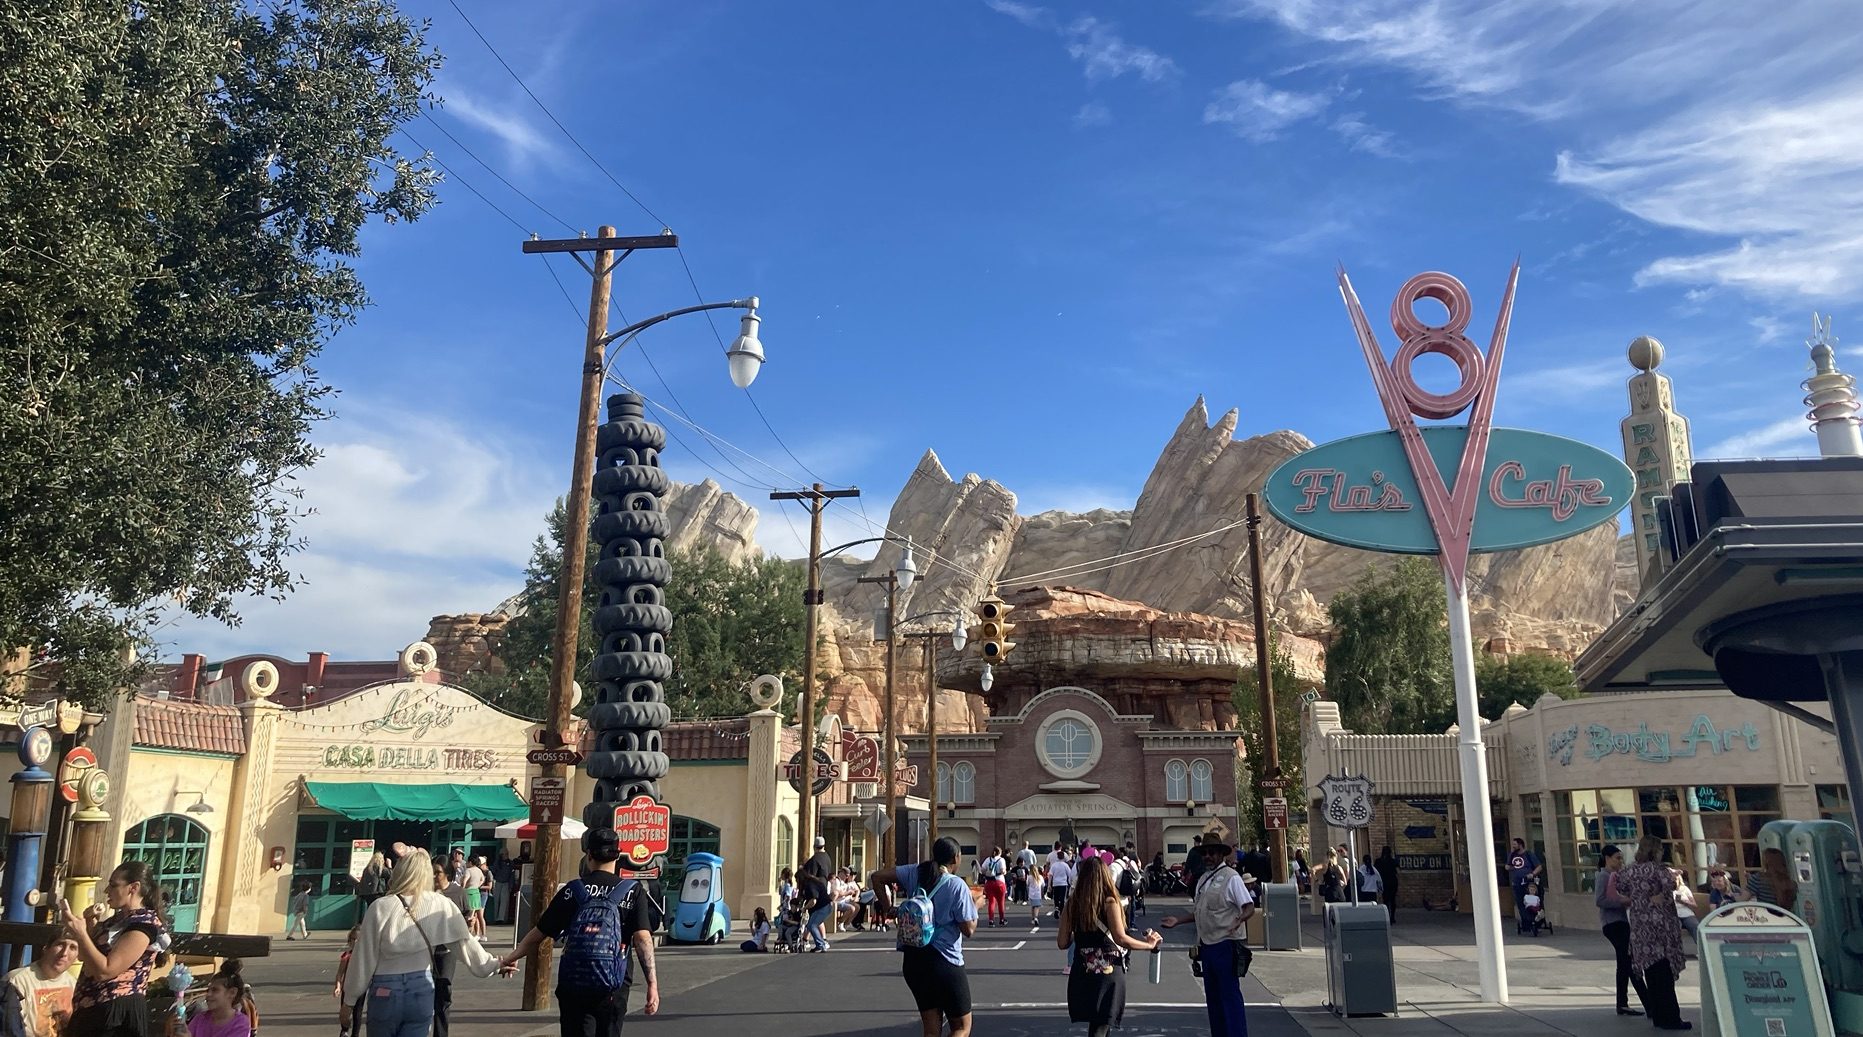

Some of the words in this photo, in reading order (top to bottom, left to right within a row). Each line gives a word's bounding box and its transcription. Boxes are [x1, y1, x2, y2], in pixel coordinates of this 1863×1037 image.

[1292, 469, 1413, 513] Flo's
[1489, 461, 1612, 522] Cafe
[23, 714, 38, 726] ONE
[38, 708, 53, 721] WAY
[1584, 720, 1671, 763] Body
[1682, 713, 1760, 755] Art
[323, 745, 375, 768] CASA
[378, 747, 439, 770] DELLA
[443, 748, 497, 772] TIRES
[532, 752, 558, 761] CROSS
[846, 744, 871, 762] Curb
[784, 764, 840, 778] TIES
[1331, 784, 1364, 796] ROUTE
[1023, 804, 1072, 812] RADIATOR
[1076, 803, 1118, 811] SPRINGS
[1330, 796, 1367, 820] 66
[616, 811, 667, 828] ROLLICKIN'
[616, 829, 667, 842] ROADSTERS
[1400, 856, 1425, 868] DROP
[1429, 856, 1441, 868] ON
